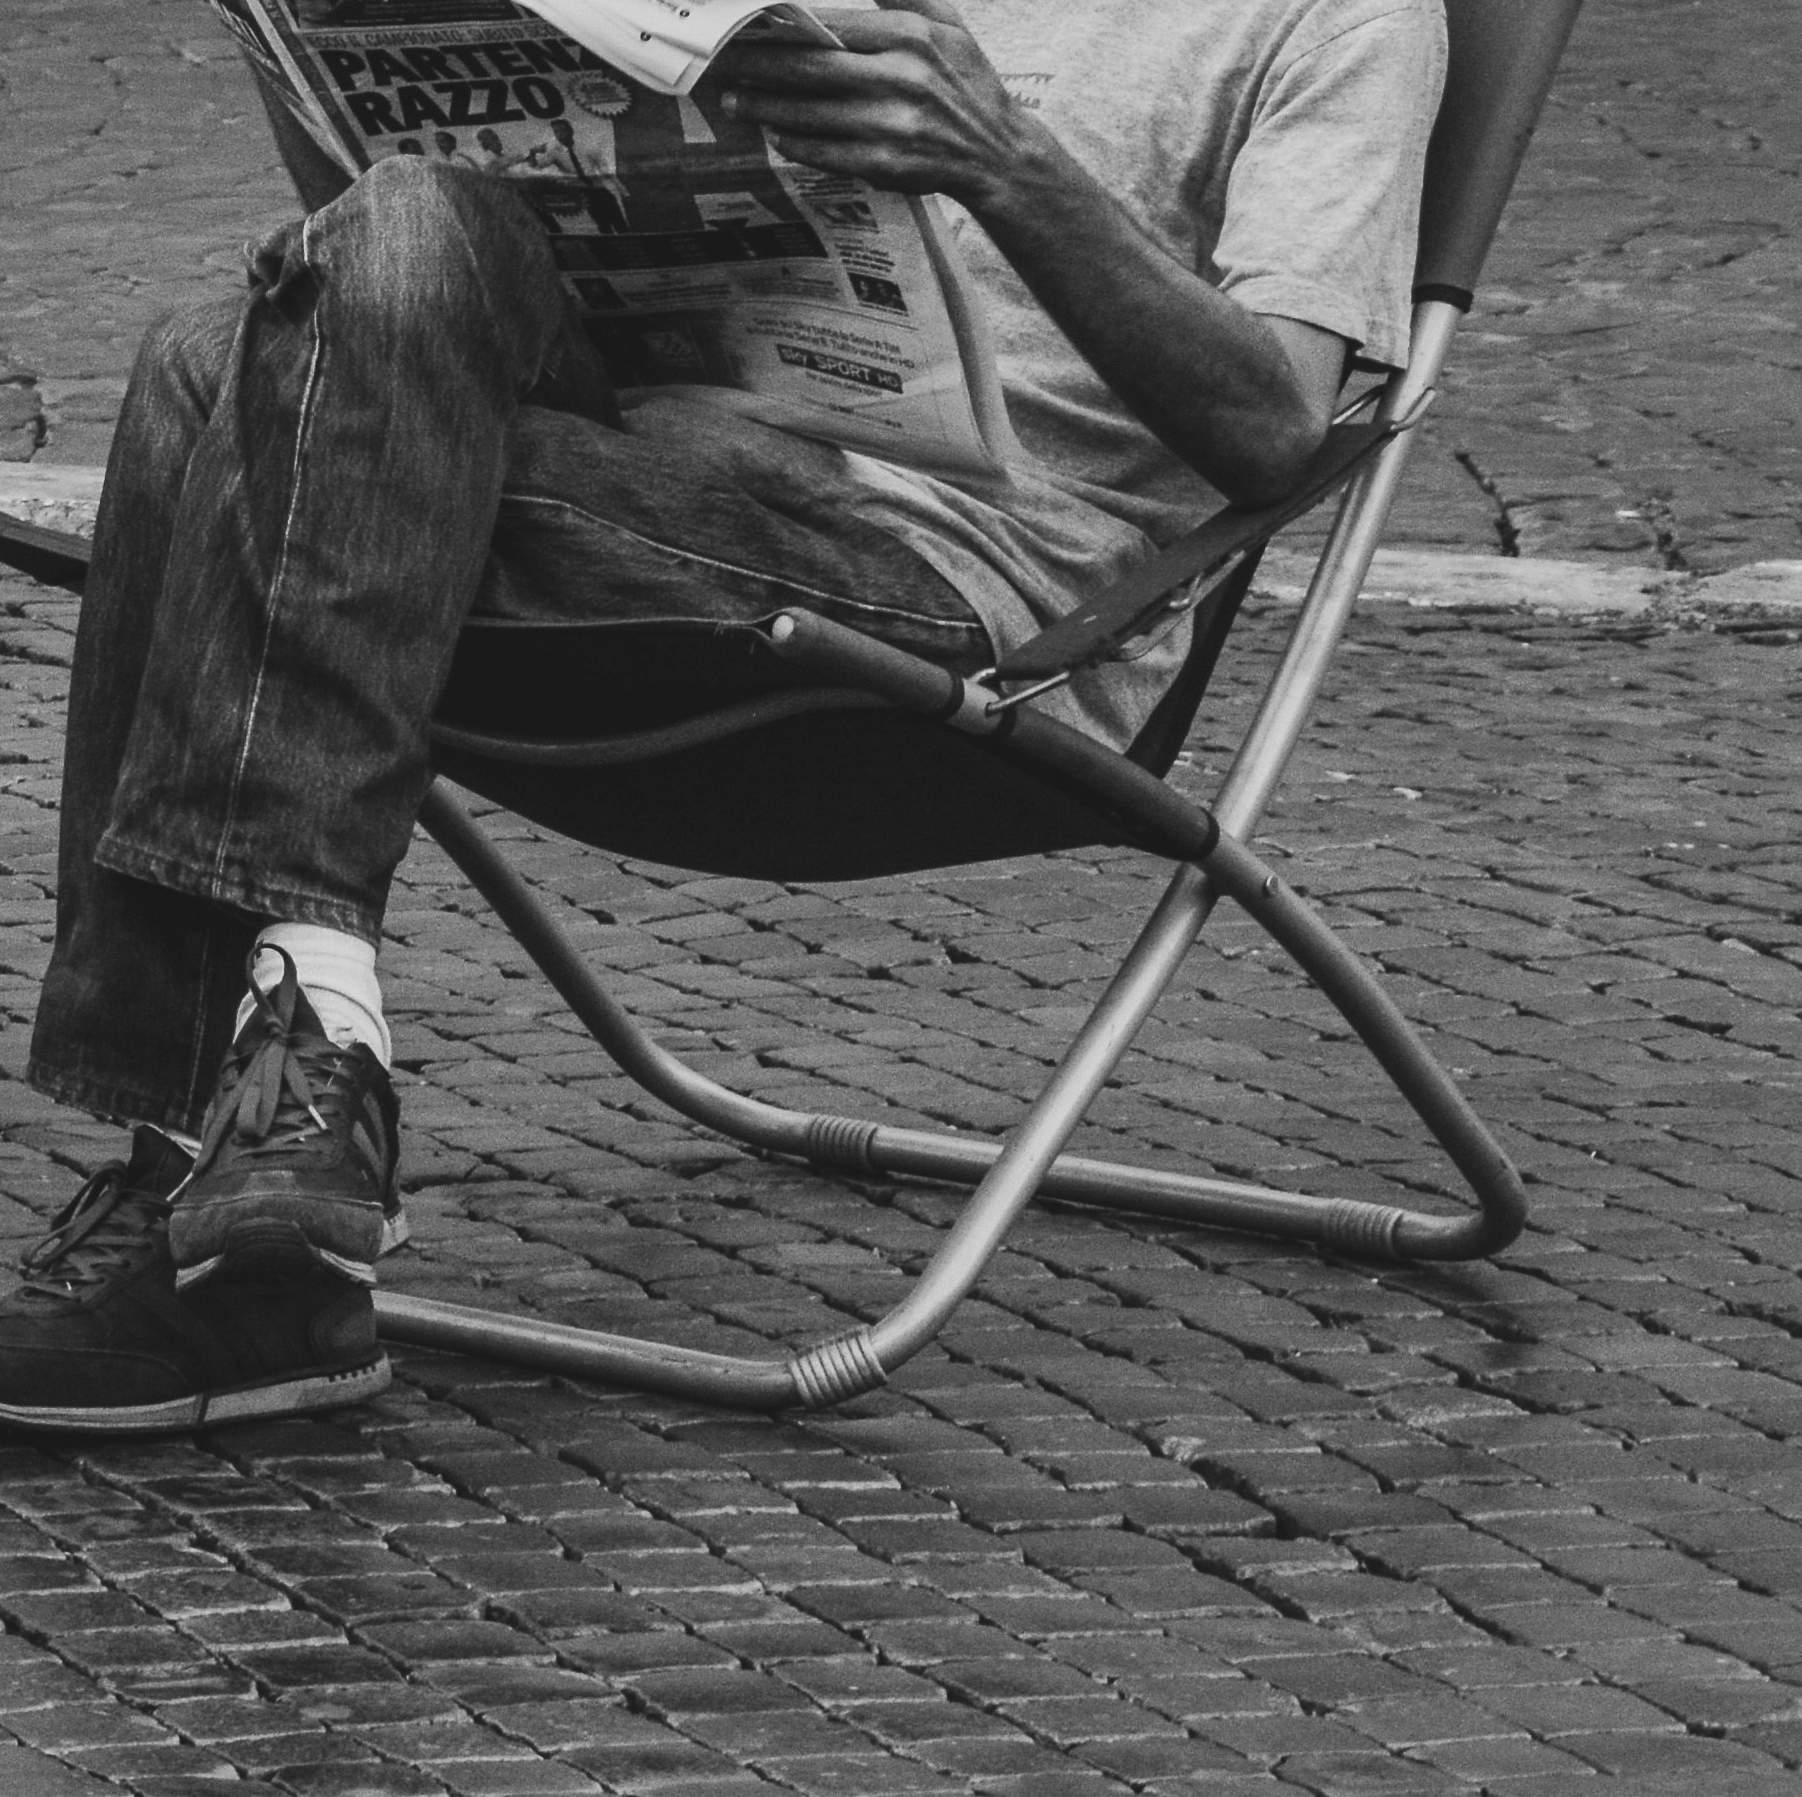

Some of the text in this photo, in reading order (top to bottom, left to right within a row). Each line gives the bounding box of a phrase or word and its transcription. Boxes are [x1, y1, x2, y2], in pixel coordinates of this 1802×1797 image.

[317, 37, 604, 93] PARTENZ
[343, 75, 566, 137] RAZZO
[814, 354, 871, 382] SPORT
